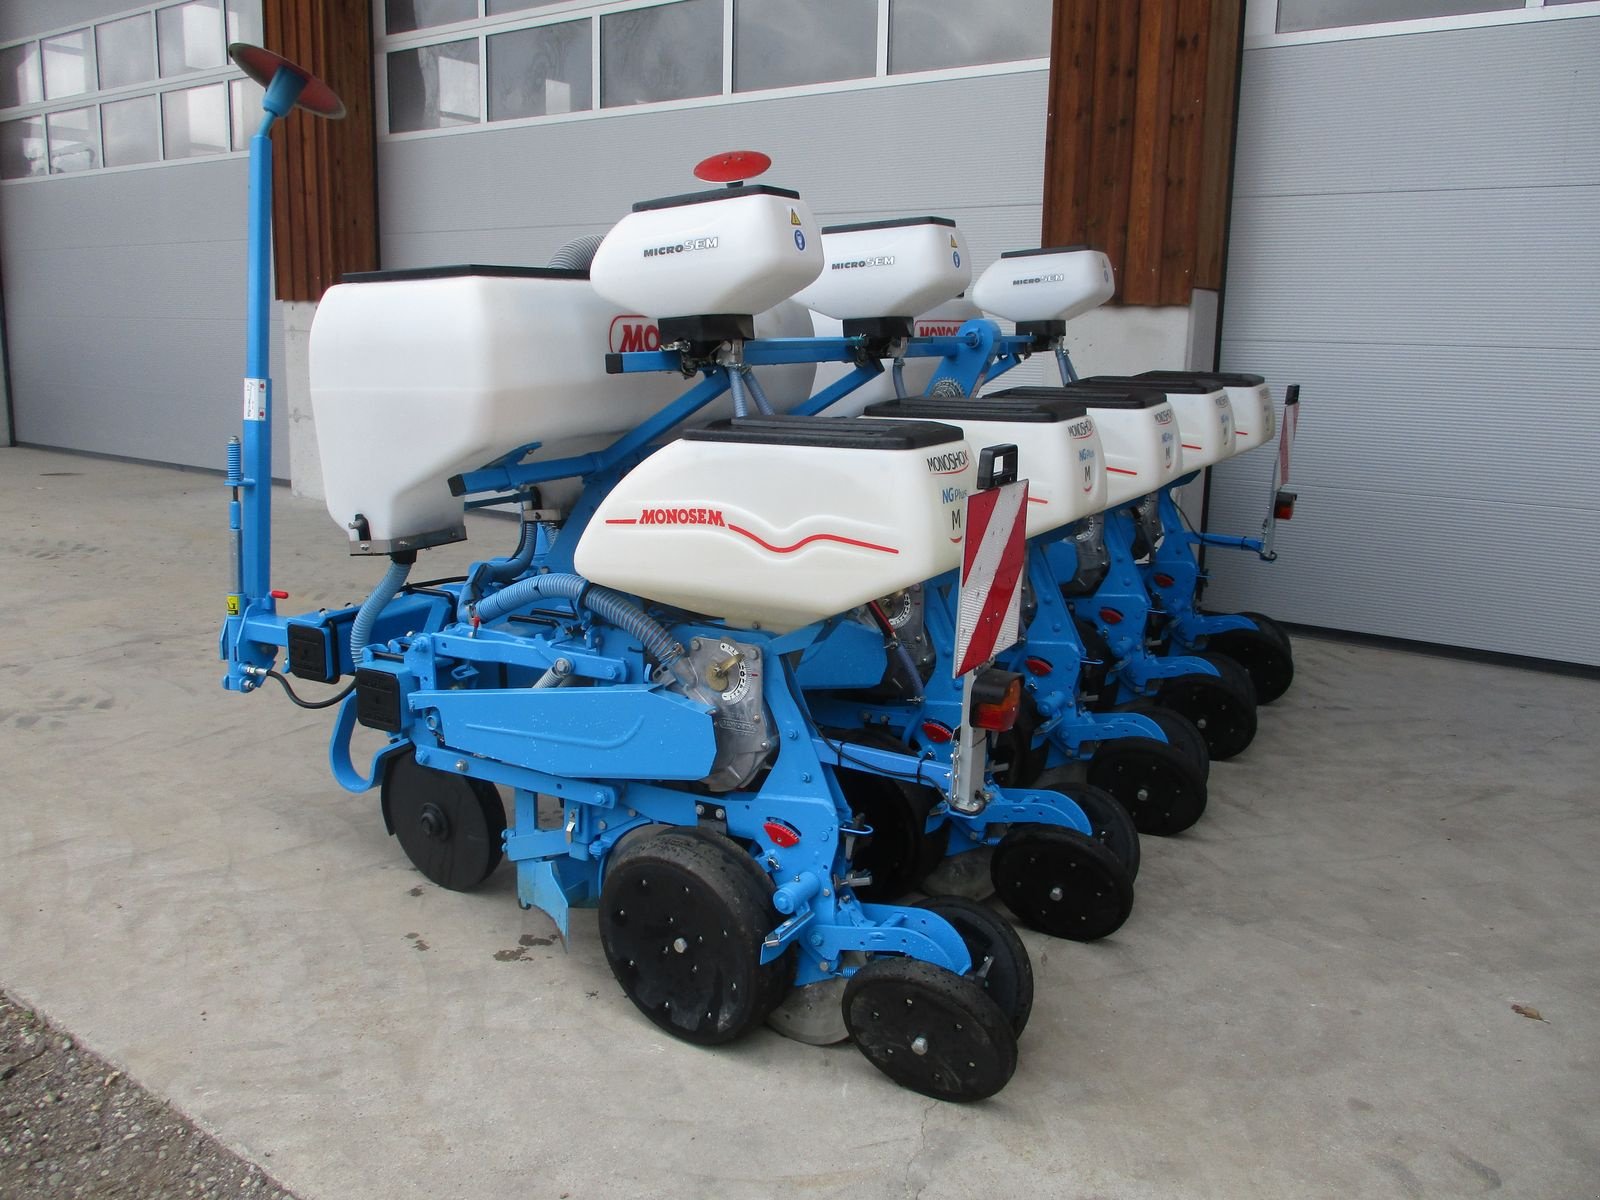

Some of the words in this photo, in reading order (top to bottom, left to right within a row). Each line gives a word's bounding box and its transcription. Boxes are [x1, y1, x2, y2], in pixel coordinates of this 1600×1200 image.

[643, 237, 719, 257] MICROSEM
[830, 256, 895, 270] MICROSEM
[942, 487, 954, 504] NG
[639, 508, 725, 527] MONOSEM
[951, 508, 961, 530] M
